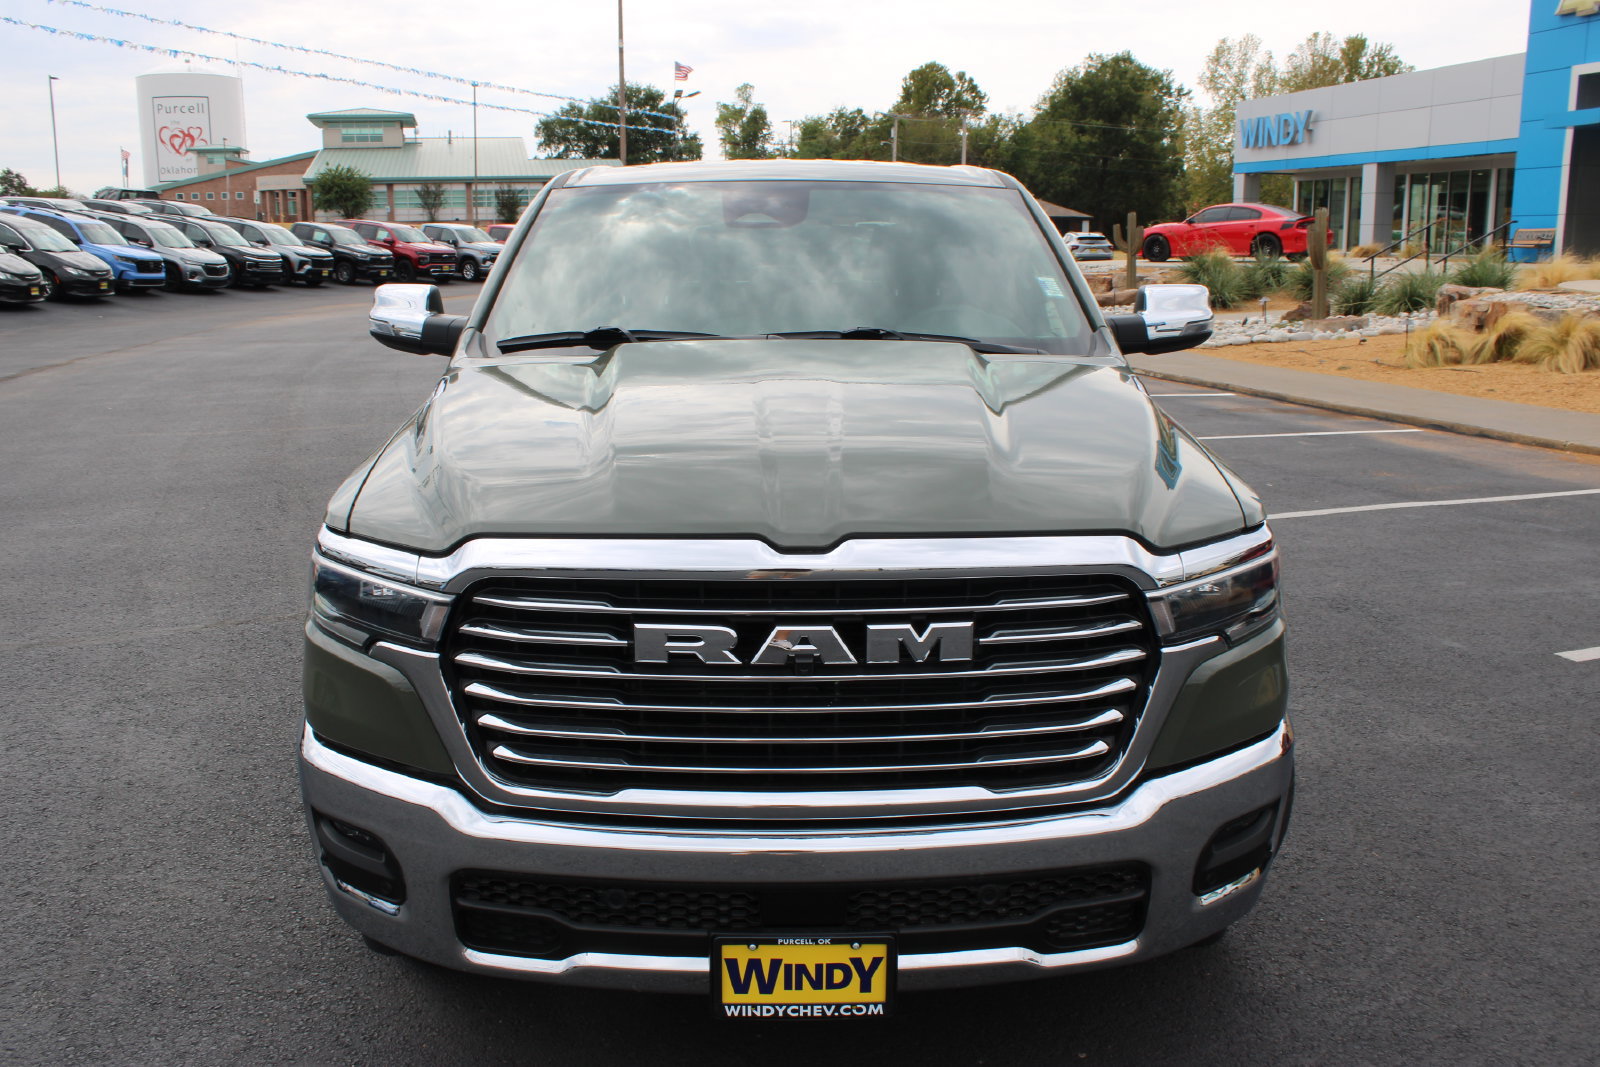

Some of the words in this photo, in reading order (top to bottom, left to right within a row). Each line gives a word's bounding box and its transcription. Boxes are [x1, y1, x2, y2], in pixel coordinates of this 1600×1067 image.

[157, 103, 205, 114] Purcell
[1240, 110, 1313, 148] WINDY
[634, 621, 974, 664] RAM
[777, 938, 816, 946] PURCELL,
[724, 956, 885, 995] WINDY
[724, 1003, 884, 1017] WINDYCHEV.COM
